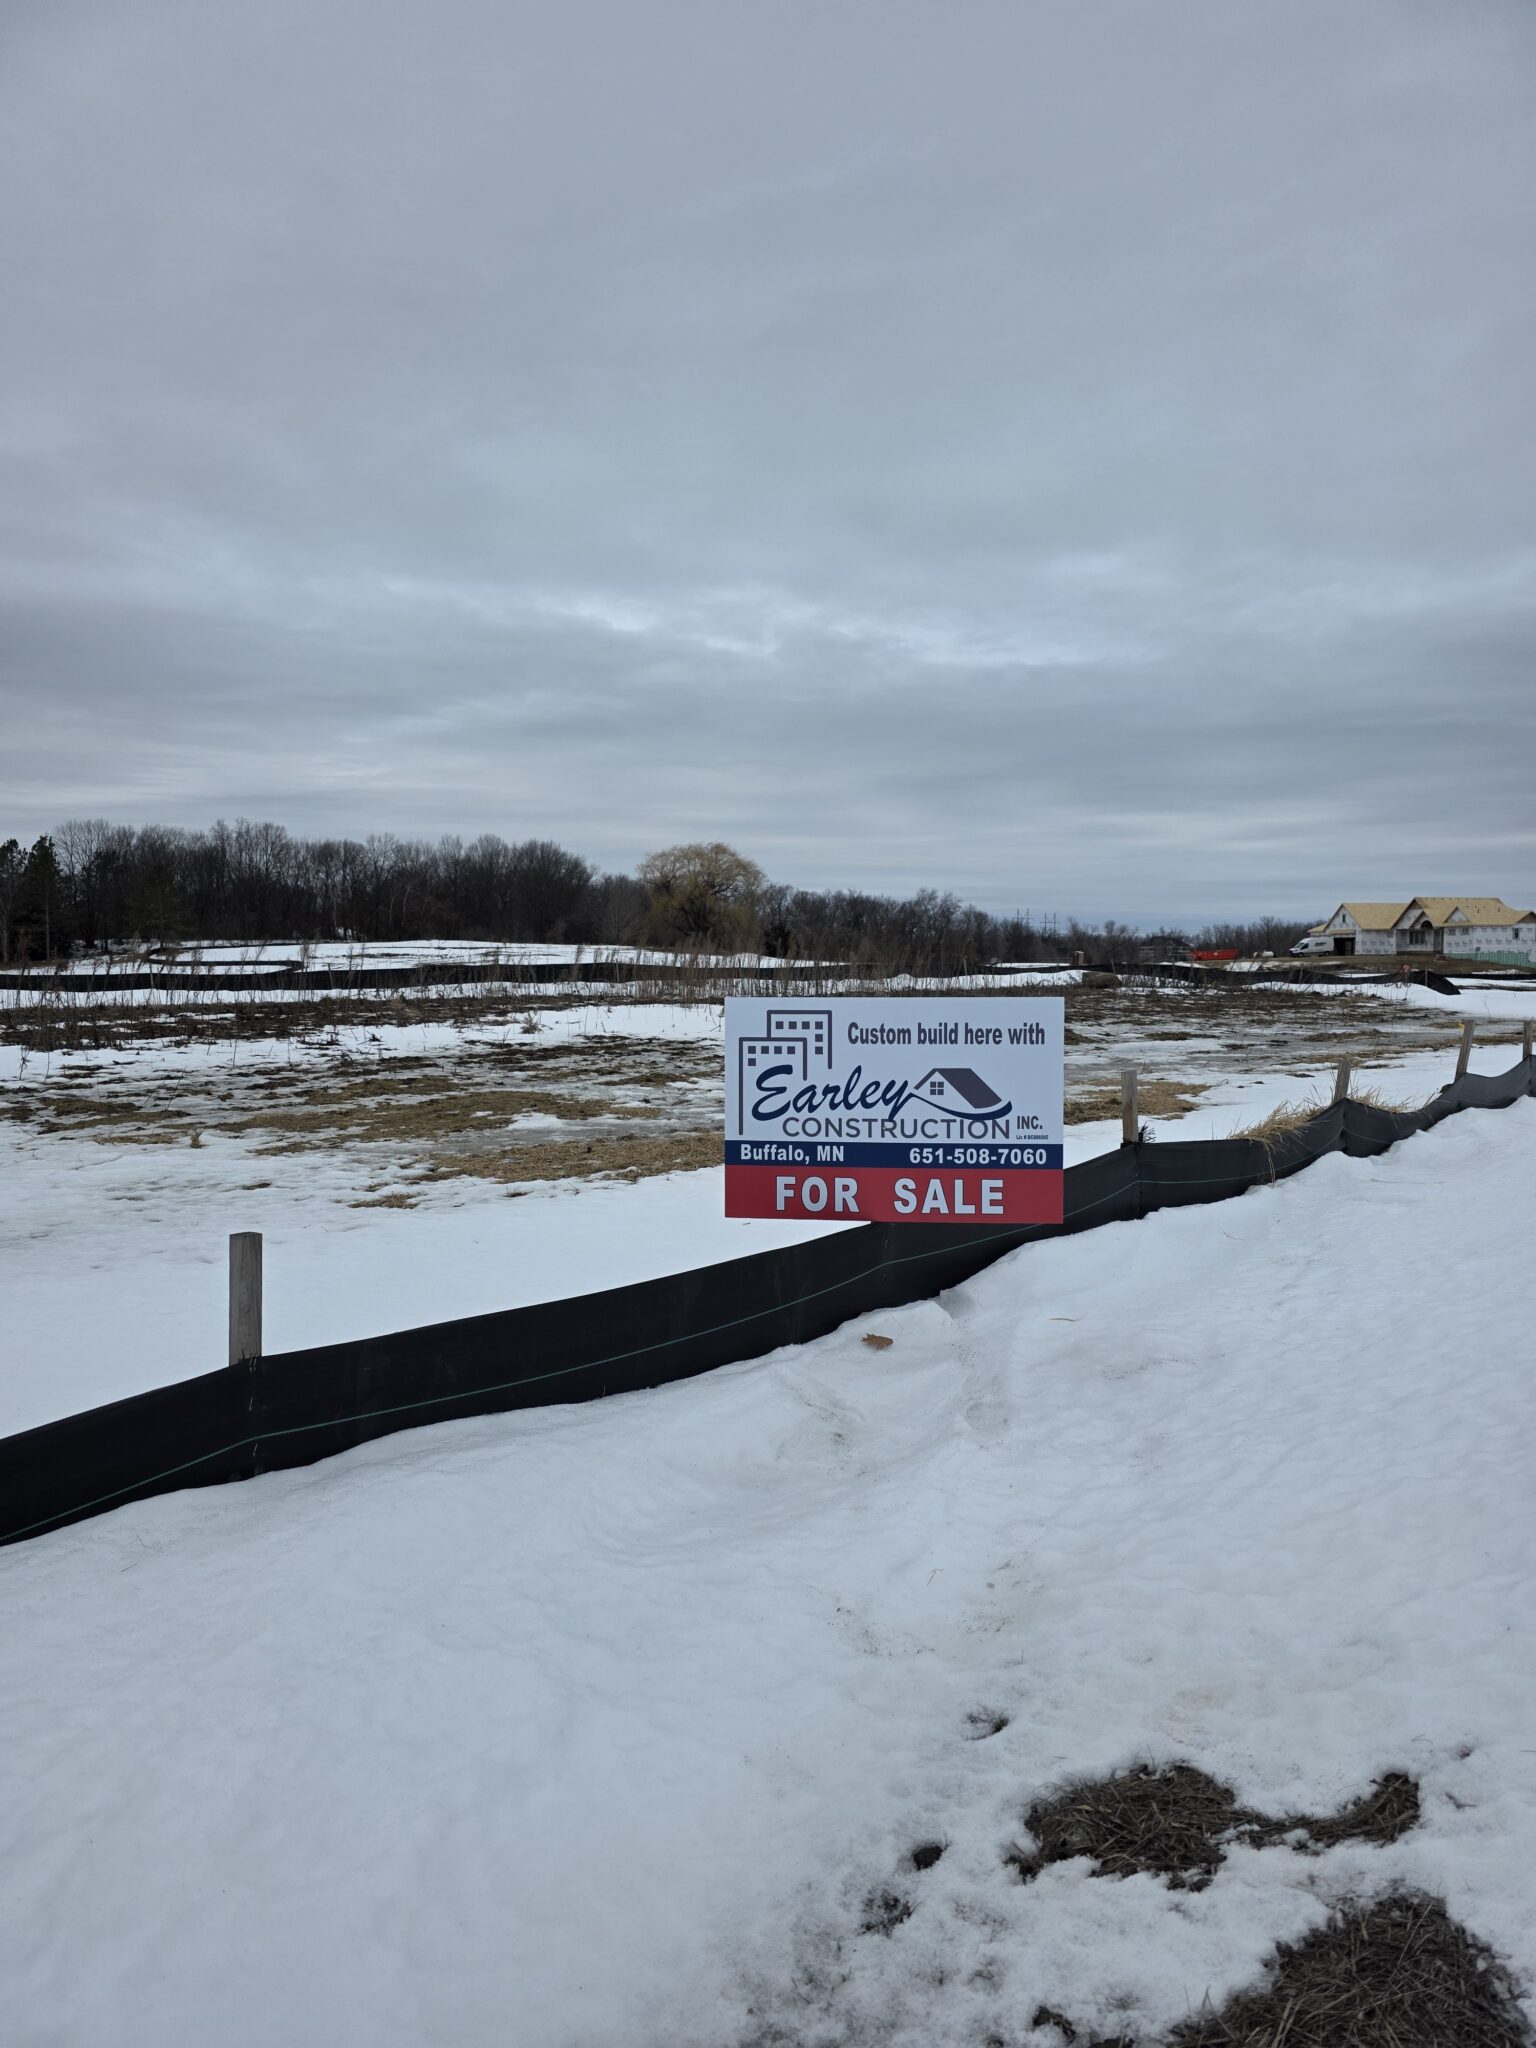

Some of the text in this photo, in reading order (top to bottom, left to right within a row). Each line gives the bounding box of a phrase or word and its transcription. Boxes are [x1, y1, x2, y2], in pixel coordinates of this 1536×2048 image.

[847, 1022, 1045, 1045] Custom build here with
[752, 1065, 916, 1122] Earley
[783, 1116, 1043, 1139] CONSTRUCTION INC.
[741, 1144, 844, 1165] Buffalo, MN
[909, 1148, 1047, 1164] 651-508-7060
[776, 1176, 1004, 1214] FOR SALE
